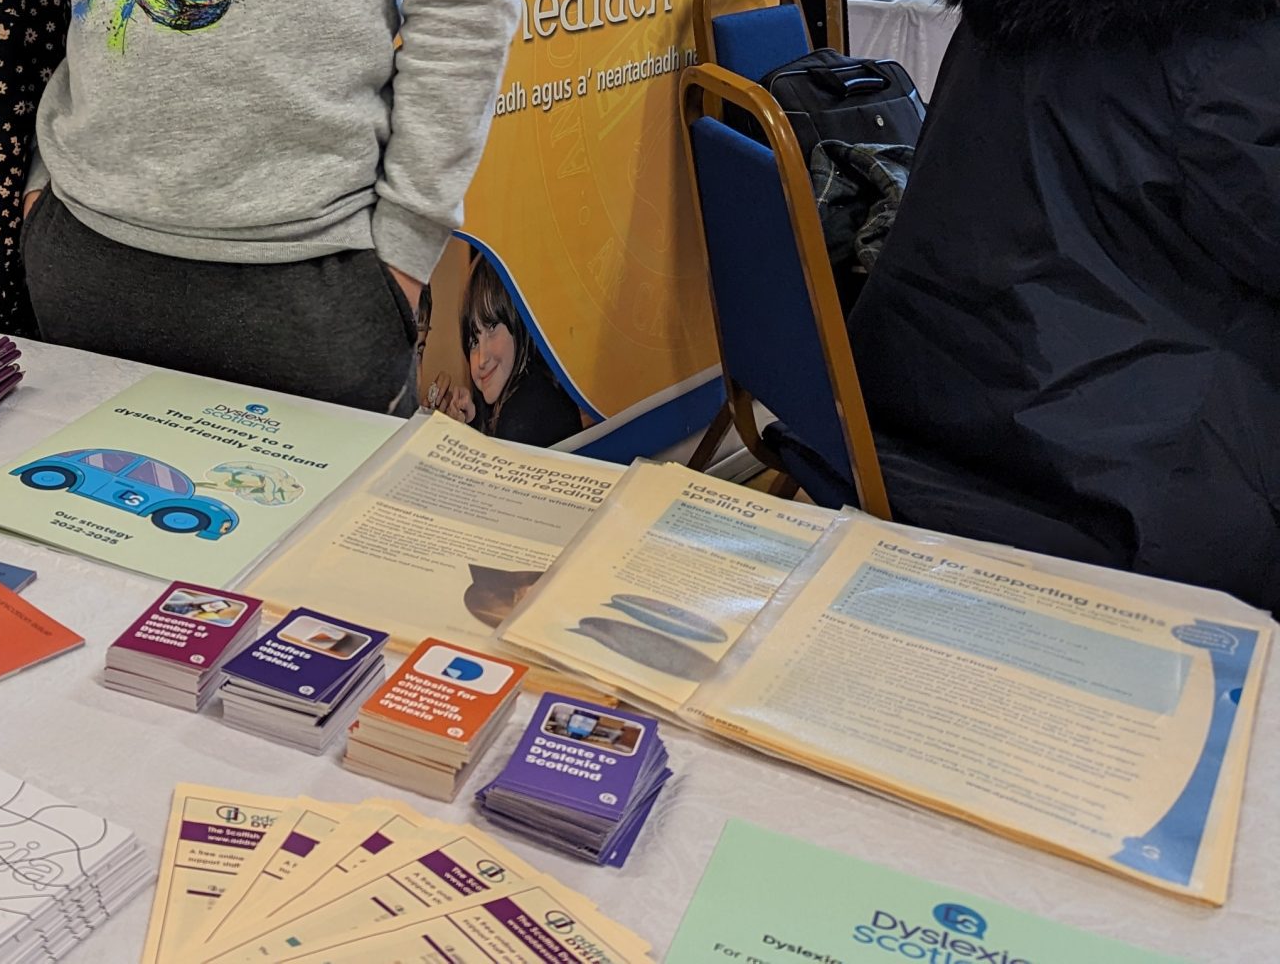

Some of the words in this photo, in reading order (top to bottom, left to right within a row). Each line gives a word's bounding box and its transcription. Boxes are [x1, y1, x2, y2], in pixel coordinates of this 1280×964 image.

[531, 77, 572, 111] agus
[597, 45, 680, 91] neartachadh
[167, 408, 193, 421] The
[194, 416, 260, 441] journey
[261, 436, 280, 446] to
[214, 404, 281, 427] Dyslexia
[114, 407, 247, 450] dyslexia-friendly
[250, 445, 329, 470] Scotland
[436, 443, 504, 475] children
[507, 468, 545, 483] and
[547, 477, 605, 496] young
[443, 434, 488, 459] Ideas
[492, 455, 514, 467] for
[519, 463, 613, 490] supporting
[427, 450, 491, 475] people
[494, 472, 529, 488] with
[533, 481, 604, 504] reading
[548, 498, 586, 511] whether
[681, 489, 756, 518] spelling
[687, 482, 740, 504] Ideas
[746, 500, 772, 514] for
[376, 501, 412, 515] General
[412, 512, 434, 522] rules
[50, 519, 120, 545] 2022-2025
[55, 510, 78, 521] Our
[80, 517, 134, 540] strategy
[876, 539, 934, 562] Ideas
[939, 556, 968, 571] for
[972, 566, 1088, 609] supporting
[1095, 600, 1167, 627] maths
[140, 625, 189, 641] Dyslexia
[145, 619, 193, 635] member
[193, 630, 209, 639] of
[150, 613, 196, 629] Become
[134, 630, 187, 648] Scotland
[265, 639, 312, 660] Leaflets
[821, 613, 847, 625] How
[864, 628, 889, 640] help
[905, 641, 952, 658] primary
[956, 655, 998, 671] school
[251, 650, 300, 671] dyslexia
[258, 645, 294, 661] about
[391, 684, 418, 698] and
[418, 693, 461, 713] young
[398, 679, 451, 702] children
[404, 672, 456, 695] Website
[457, 689, 478, 701] for
[379, 698, 435, 722] dyslexia
[384, 691, 431, 714] people
[431, 706, 463, 722] with
[529, 745, 602, 772] Dyslexia
[534, 736, 597, 760] Donate
[598, 753, 618, 765] to
[525, 754, 603, 782] Scotland
[207, 826, 225, 834] The
[225, 829, 262, 840] Scottish
[188, 856, 220, 867] support
[451, 866, 467, 879] The
[516, 914, 532, 928] The
[713, 942, 743, 960] For
